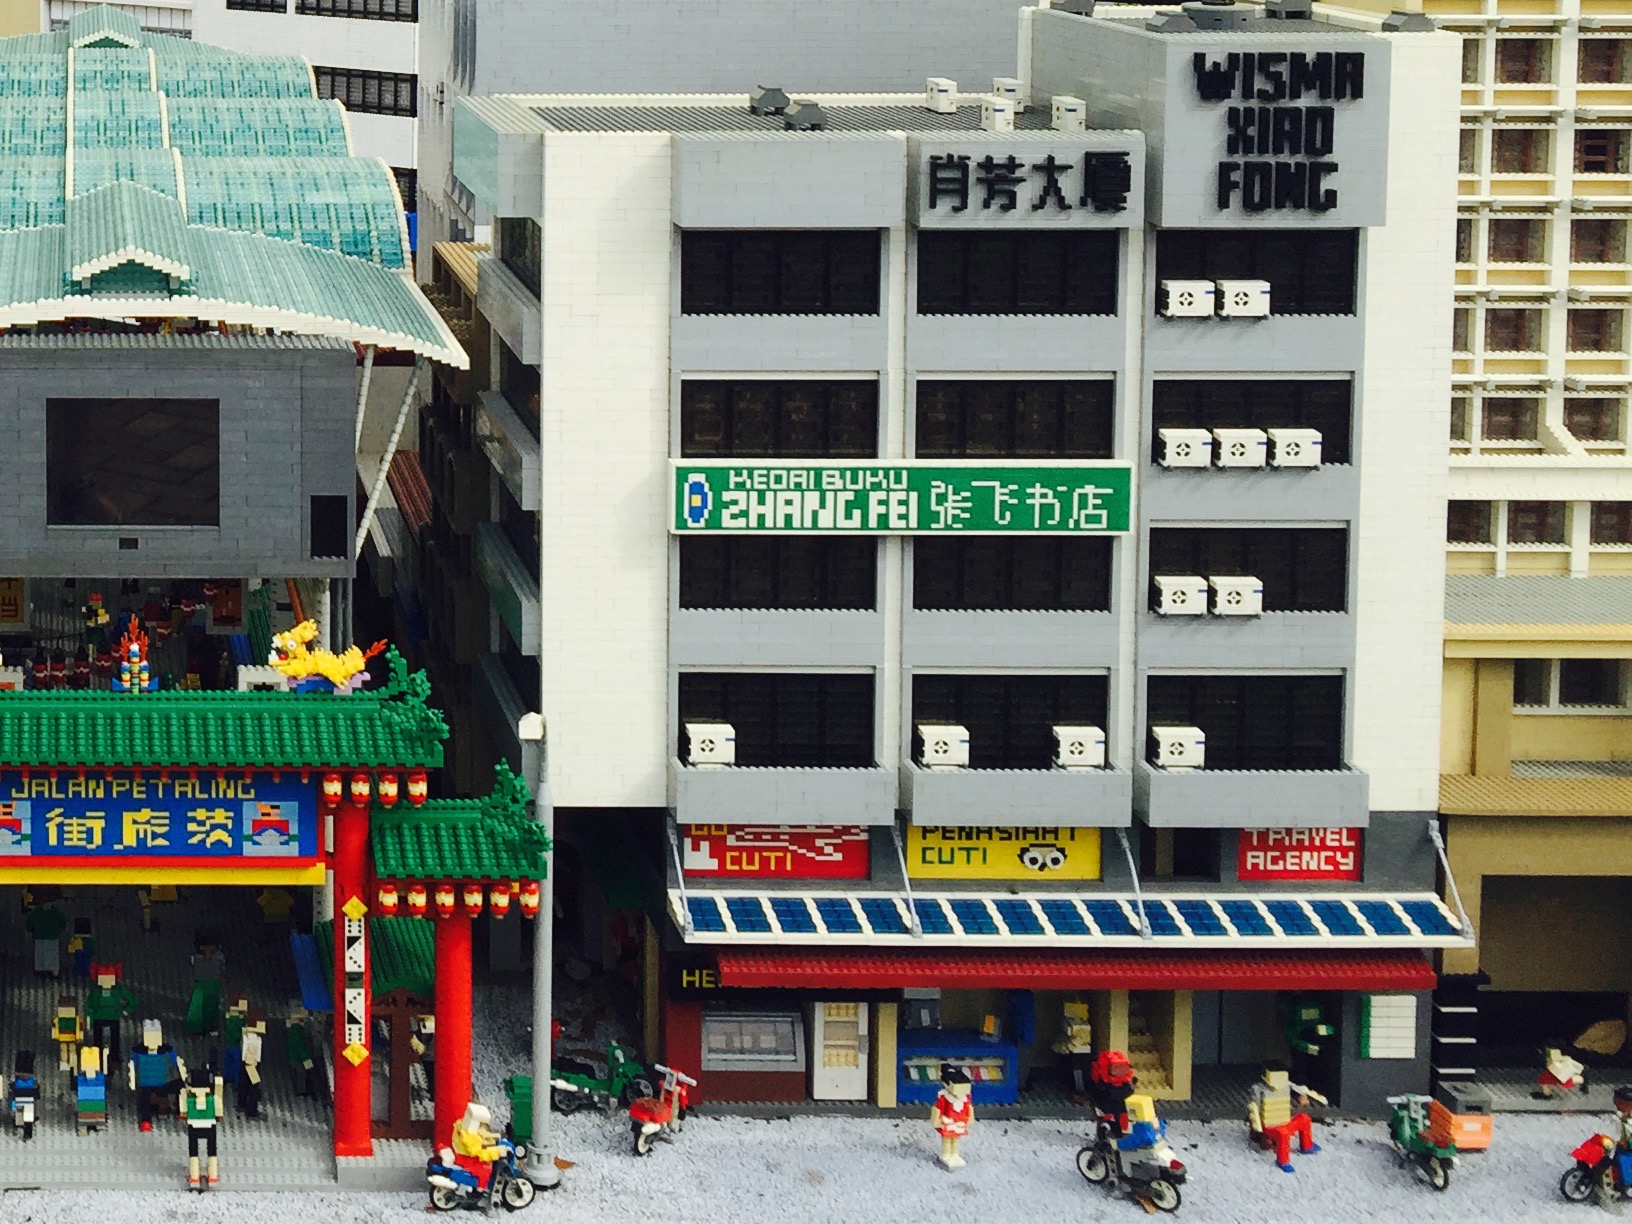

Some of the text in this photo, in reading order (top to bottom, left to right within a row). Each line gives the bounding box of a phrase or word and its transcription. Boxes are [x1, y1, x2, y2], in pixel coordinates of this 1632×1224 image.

[1193, 51, 1365, 101] WISMA
[1226, 105, 1335, 156] XIAO
[1217, 161, 1339, 212] FONG
[729, 469, 908, 490] KEDAI BUKU
[721, 490, 919, 529] ZHANG FEI
[11, 779, 256, 799] JALAN PETALING
[1244, 828, 1356, 847] TRAVEL
[726, 851, 792, 871] CUTI
[921, 846, 987, 865] CUTI
[1246, 851, 1355, 871] AGENCY
